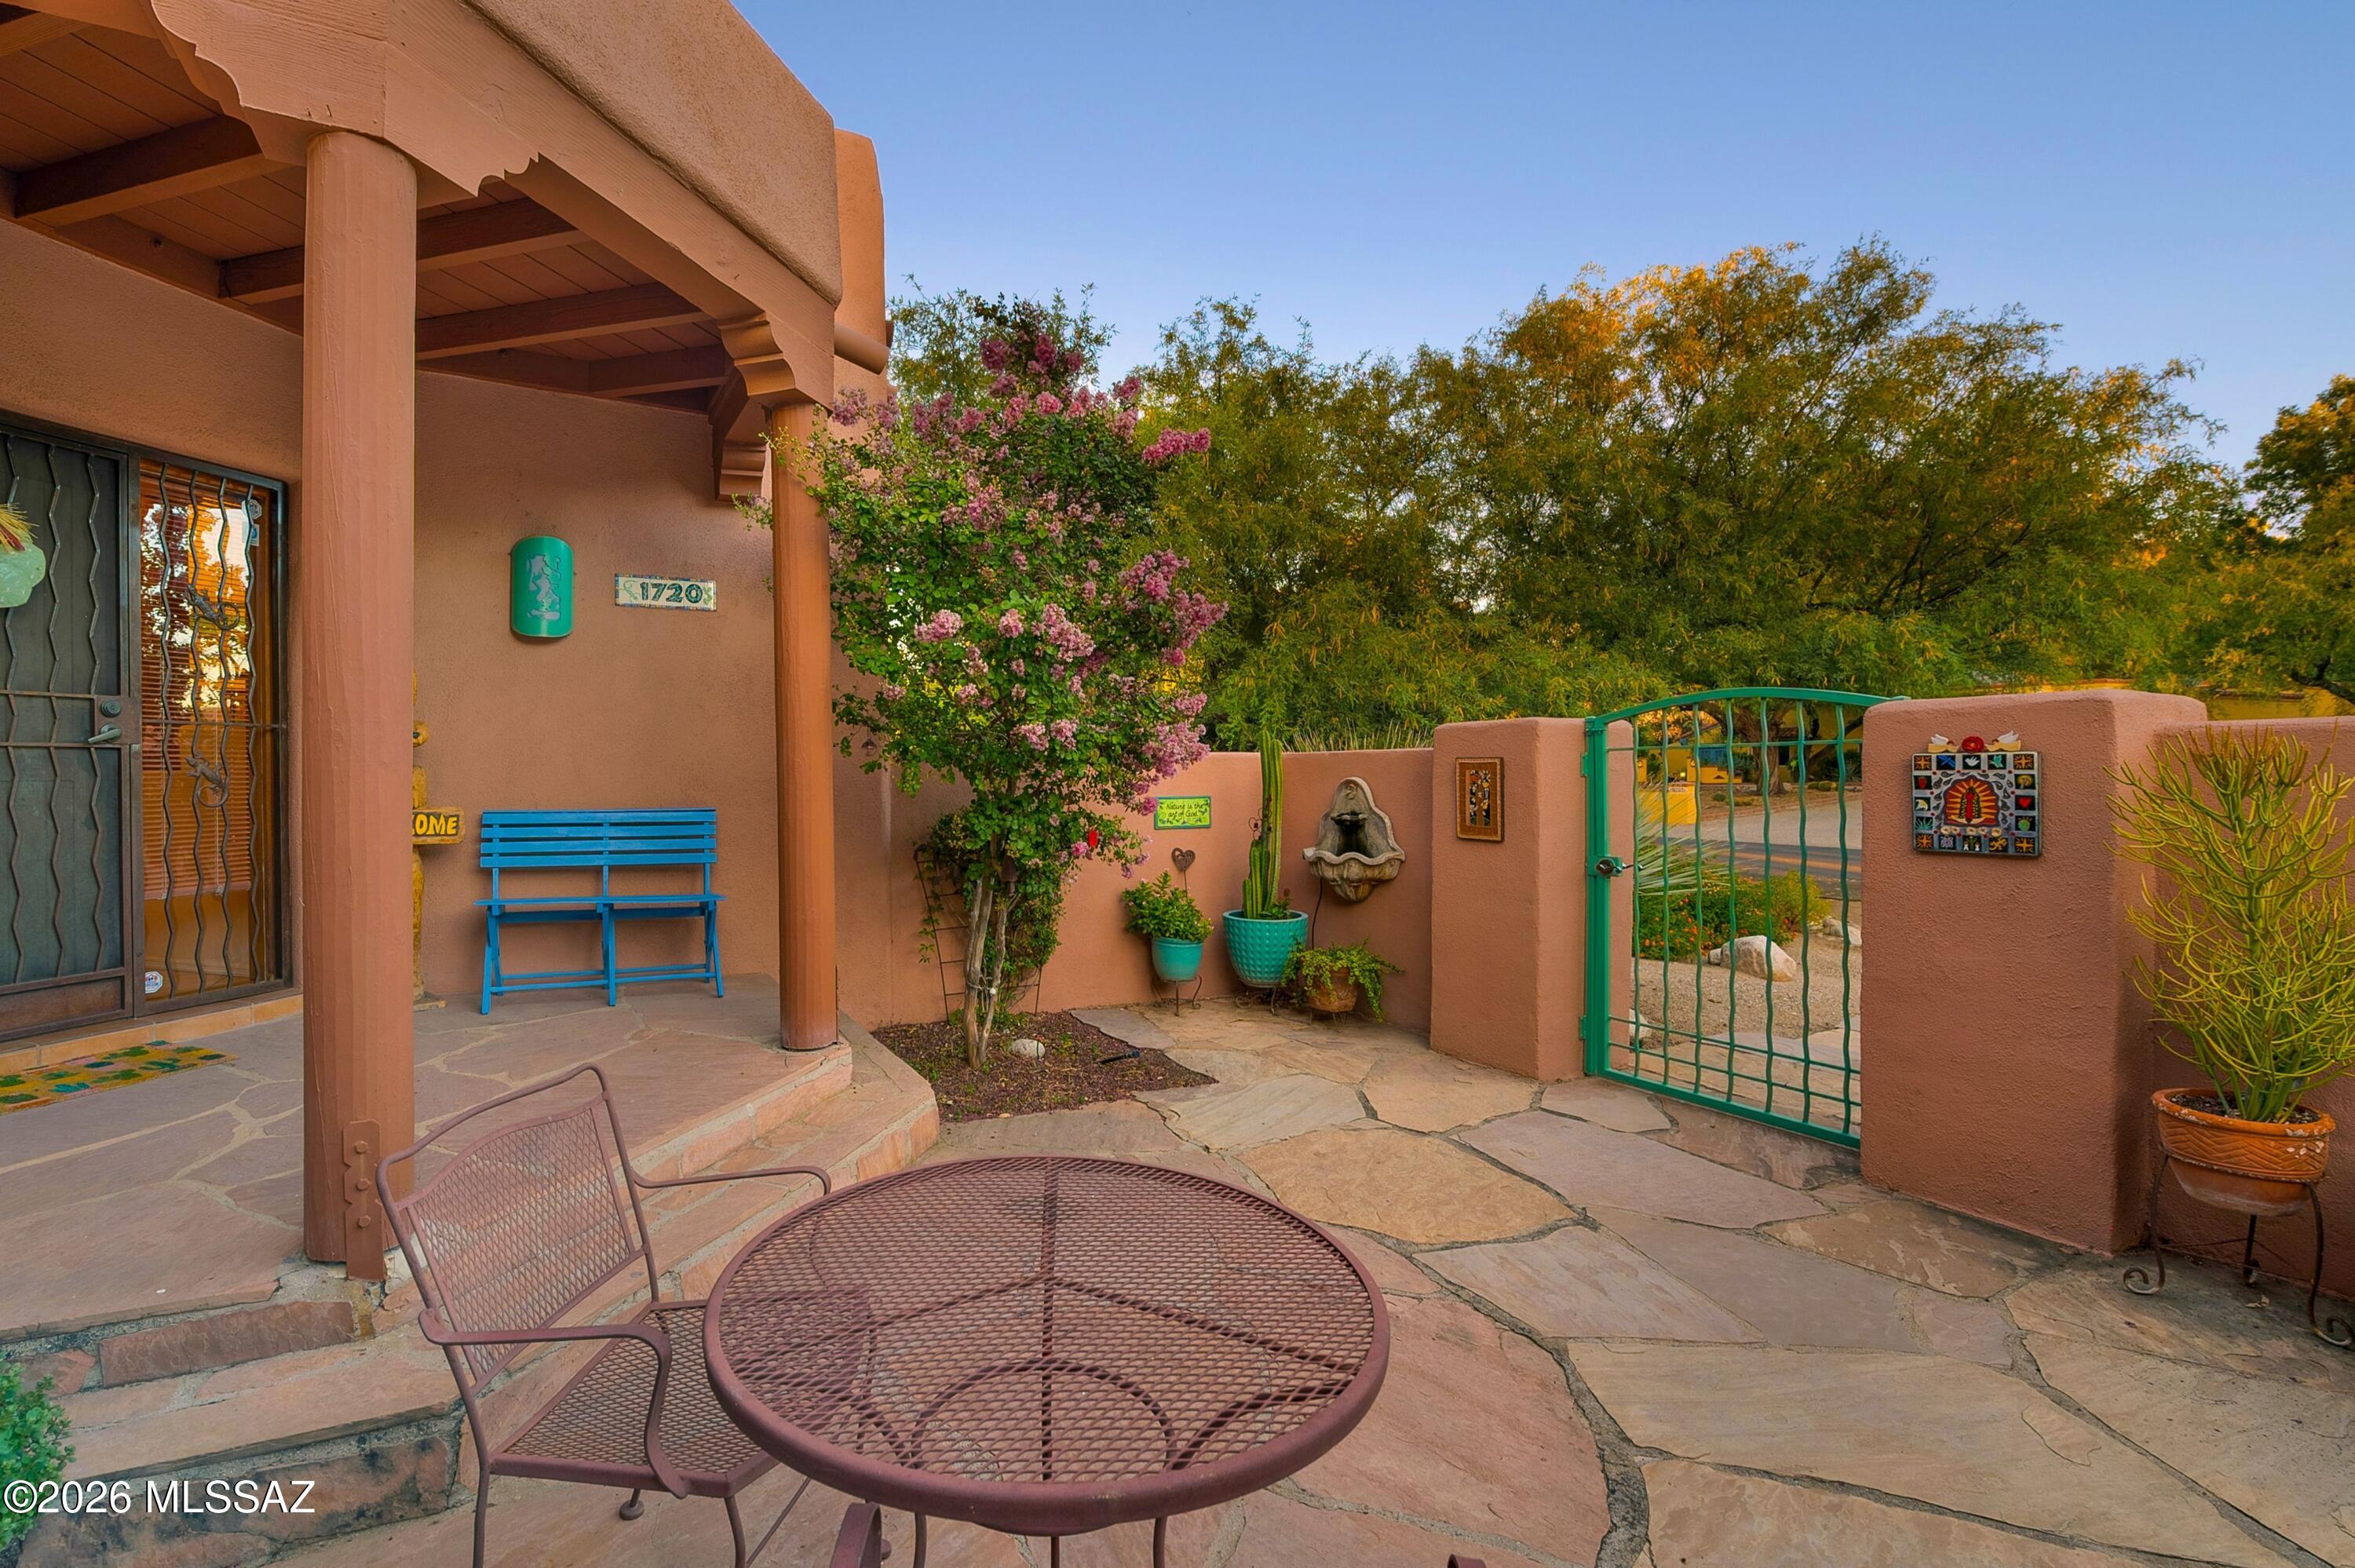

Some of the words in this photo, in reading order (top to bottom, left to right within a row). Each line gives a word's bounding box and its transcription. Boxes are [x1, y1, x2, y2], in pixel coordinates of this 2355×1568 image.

[640, 582, 703, 603] 1720
[412, 813, 458, 835] OME
[1178, 810, 1185, 820] of
